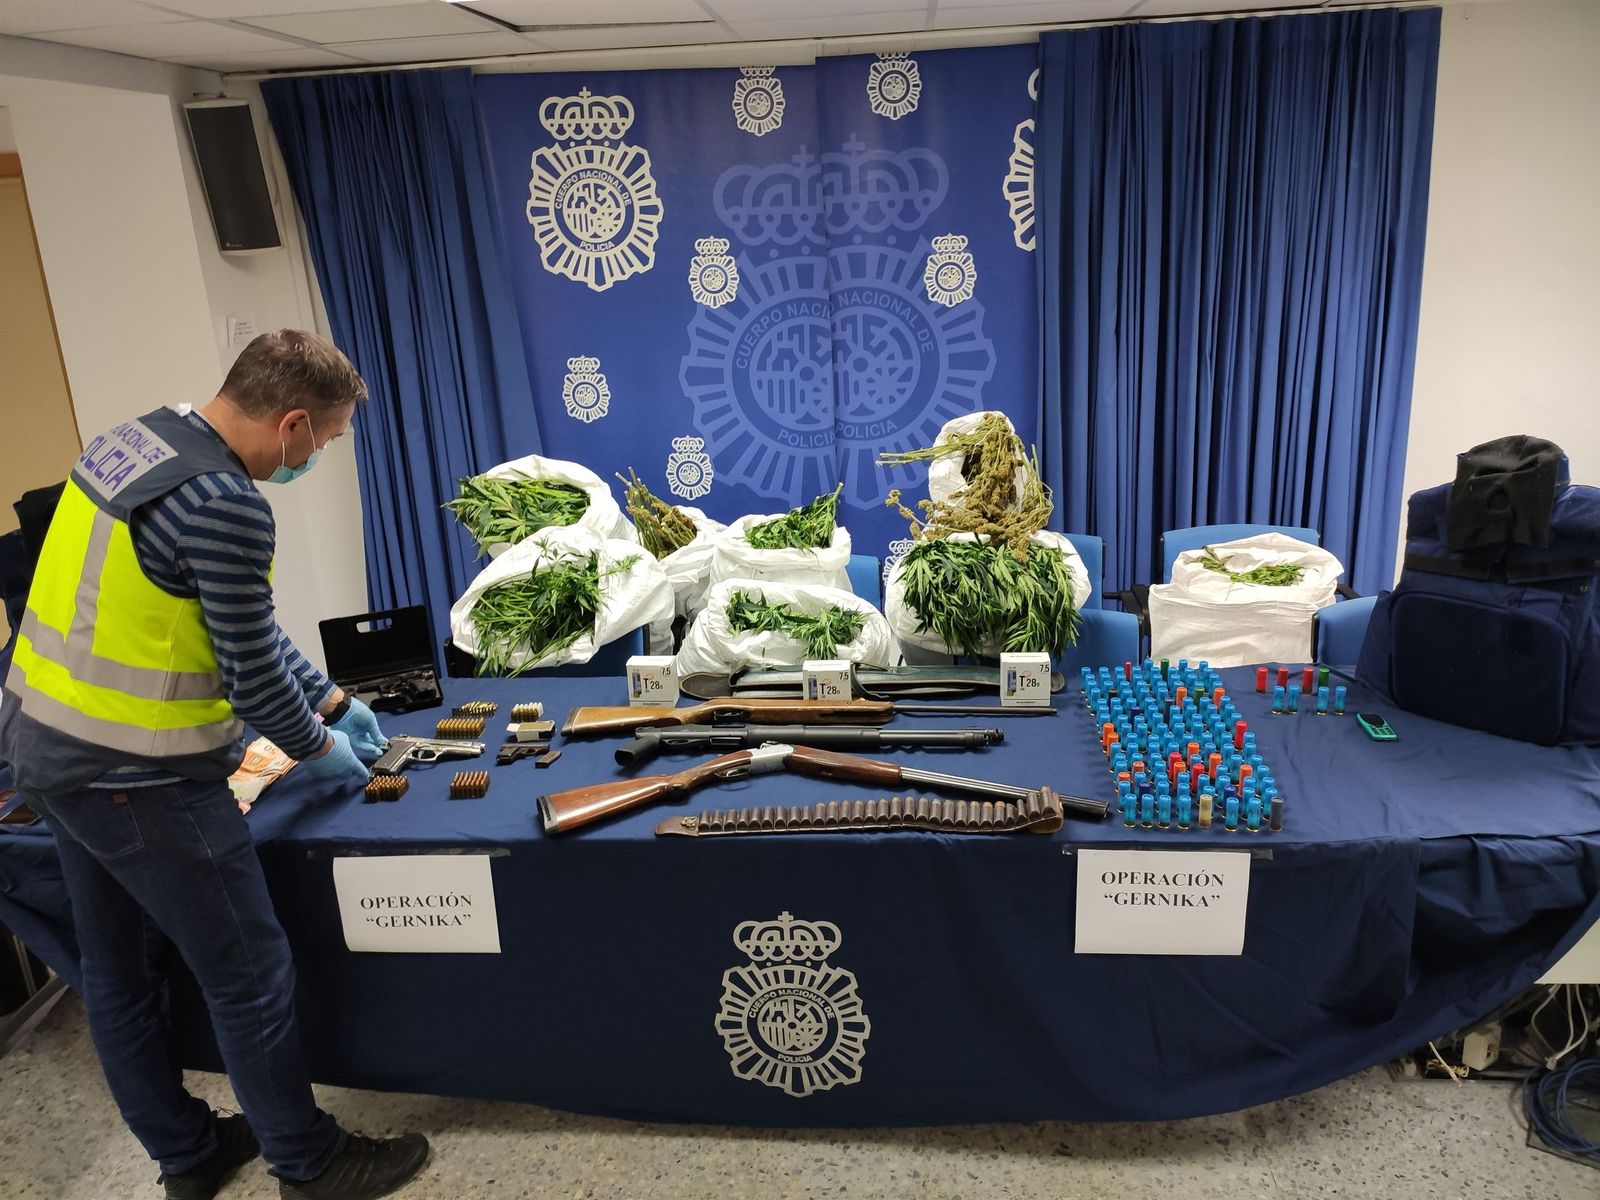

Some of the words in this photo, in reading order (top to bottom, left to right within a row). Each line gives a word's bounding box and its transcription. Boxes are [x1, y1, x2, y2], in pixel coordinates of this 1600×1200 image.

[554, 174, 579, 209] CUERPO
[579, 170, 623, 193] NACIONAL
[621, 191, 632, 207] DE
[580, 240, 616, 252] POLICIA
[838, 291, 919, 326] NACIONAL
[916, 328, 934, 354] DE
[736, 309, 783, 369] CUERPO
[836, 419, 898, 438] POLICIA
[80, 435, 137, 492] OLICIA
[142, 446, 166, 464] DE
[1101, 869, 1225, 887] OPERACIÓN
[360, 891, 472, 909] OPERACIÓN
[1104, 892, 1221, 907] “GERNIKA”
[366, 914, 471, 928] “GERNIKA”
[748, 991, 777, 1018] CUERPO
[778, 988, 827, 1008] NACIONAL
[824, 1006, 835, 1020] DE
[777, 1053, 814, 1063] POLICIA
